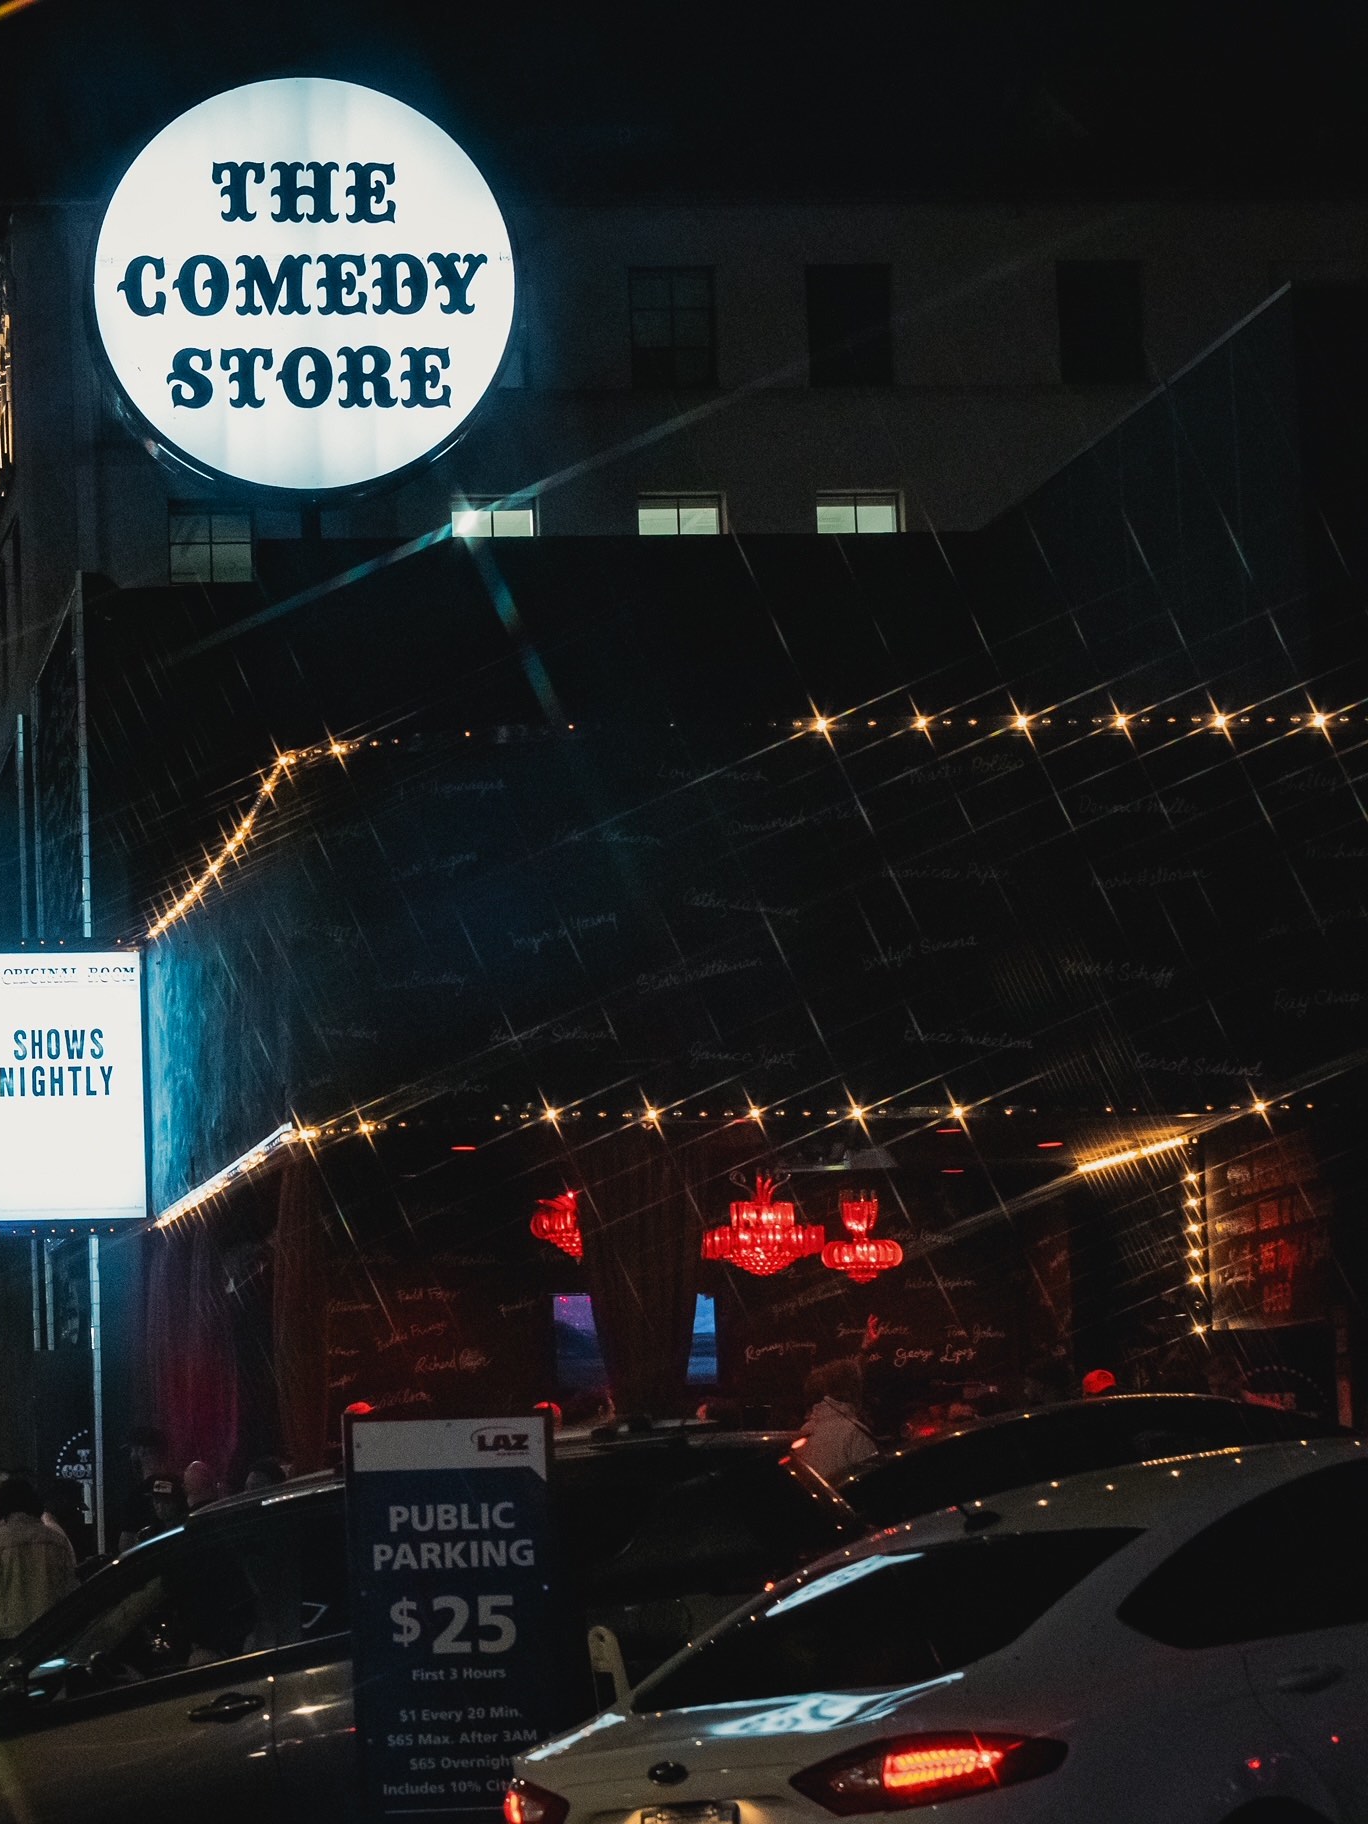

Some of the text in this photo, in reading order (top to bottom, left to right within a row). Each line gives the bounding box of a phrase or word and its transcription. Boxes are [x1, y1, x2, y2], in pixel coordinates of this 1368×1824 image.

[212, 161, 396, 223] THE
[116, 252, 488, 317] COMEDY
[166, 346, 452, 409] STORE
[13, 1028, 104, 1060] SHOWS
[0, 1065, 113, 1097] NIGHTLY
[477, 1434, 529, 1451] LAZ
[388, 1502, 515, 1532] PUBLIC
[373, 1539, 535, 1571] PARKING
[389, 1595, 517, 1654] $25
[411, 1667, 507, 1681] First 3 Hours
[399, 1705, 523, 1723] $1 Every 20 Min.
[387, 1729, 537, 1747] $65 Max. After 3AM
[409, 1758, 436, 1771] $65
[383, 1781, 445, 1796] Includes
[450, 1780, 481, 1793] 10%
